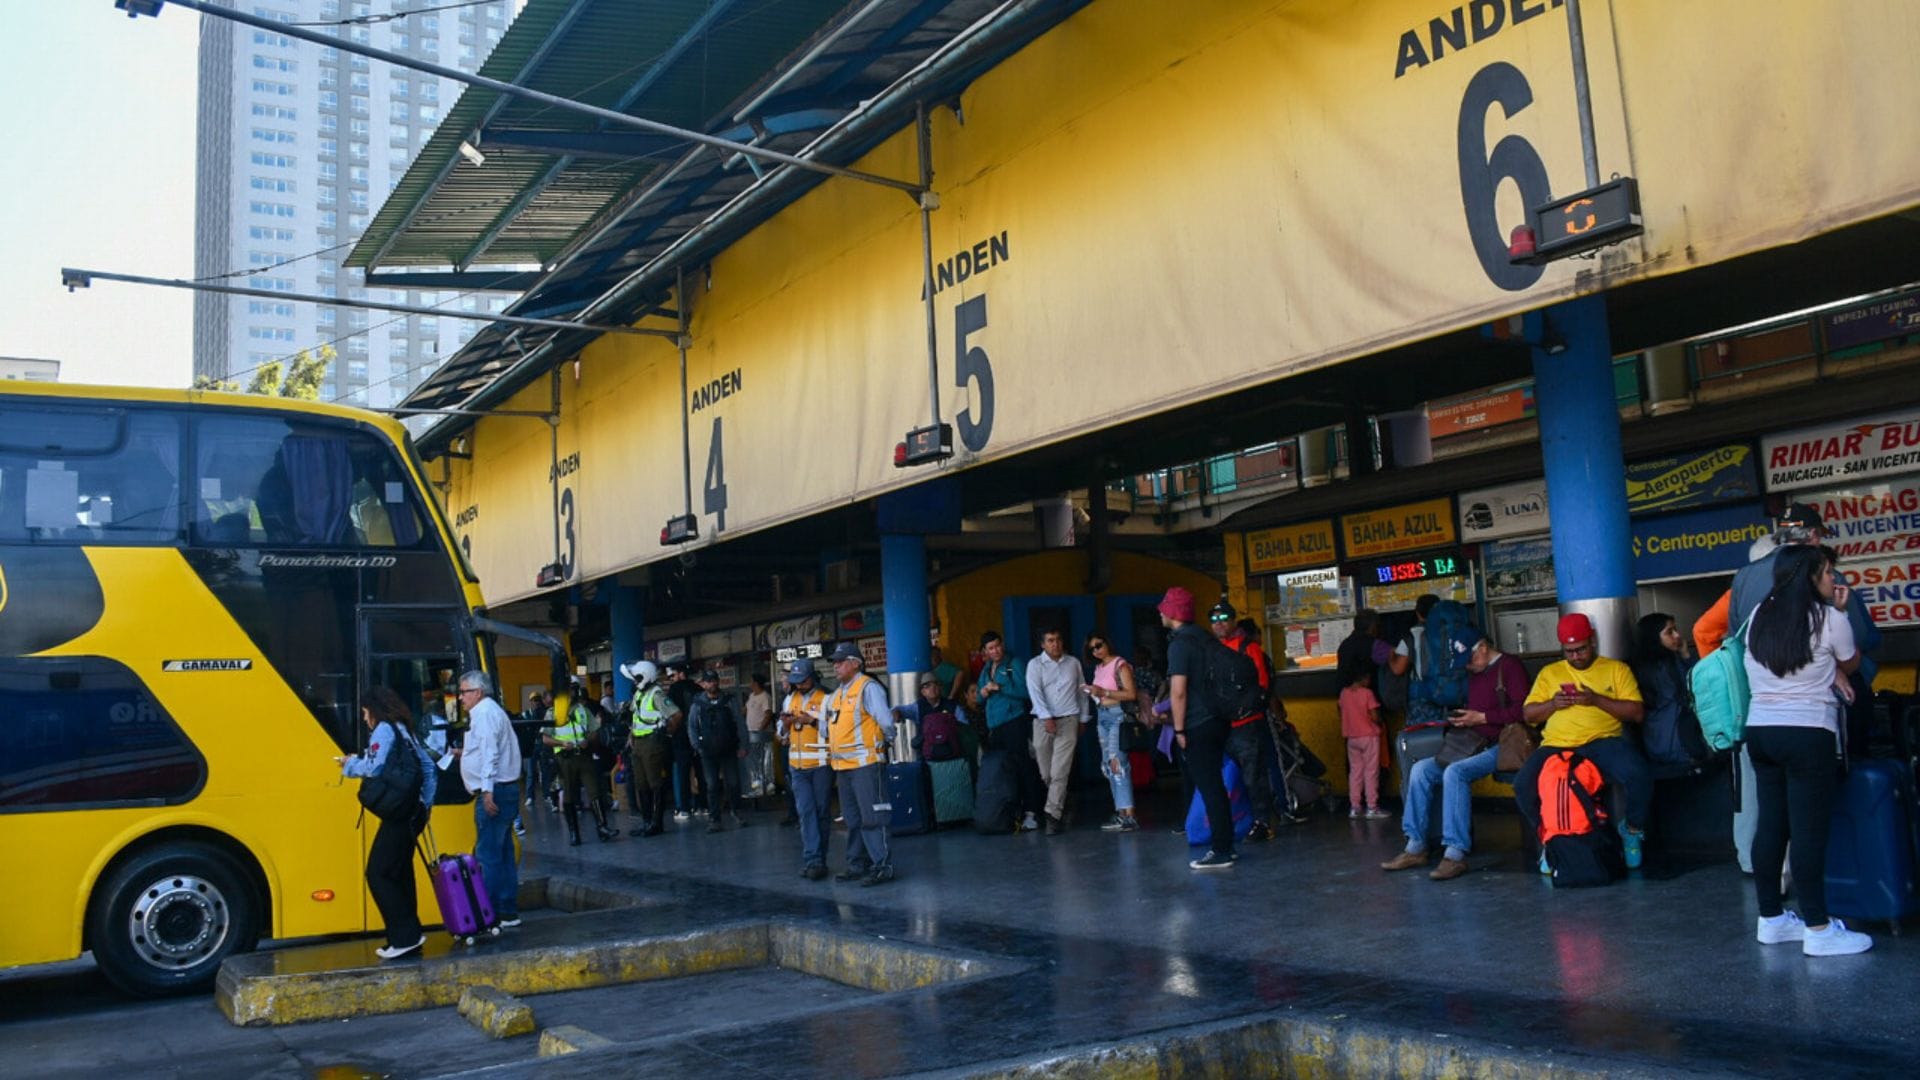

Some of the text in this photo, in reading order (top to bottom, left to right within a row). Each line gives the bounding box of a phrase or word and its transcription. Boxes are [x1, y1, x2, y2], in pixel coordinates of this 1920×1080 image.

[1395, 0, 1566, 78] ANDE
[1458, 62, 1550, 290] 6
[922, 231, 1008, 301] ANDEN
[955, 293, 994, 452] 5
[692, 367, 742, 414] ANDEN
[550, 450, 581, 483] ANDEN
[1770, 433, 1864, 469] RIMAR
[704, 416, 727, 532] 4
[1644, 447, 1733, 498] Aeropuerto
[1771, 464, 1834, 486] RANCAGUA
[1844, 458, 1869, 475] SAN
[1505, 501, 1540, 517] LUNA
[561, 487, 575, 581] 3
[1352, 519, 1397, 546] BAHIA
[1404, 512, 1443, 537] AZUL
[1647, 523, 1769, 554] Centropuerto
[370, 556, 397, 567] DD
[1256, 537, 1293, 561] BAHIA
[1298, 531, 1330, 554] AZUL
[1834, 539, 1898, 556] IMAR
[1286, 571, 1336, 586] CARTAGENA
[1377, 561, 1427, 583] BUSES
[1857, 583, 1920, 603] ENG
